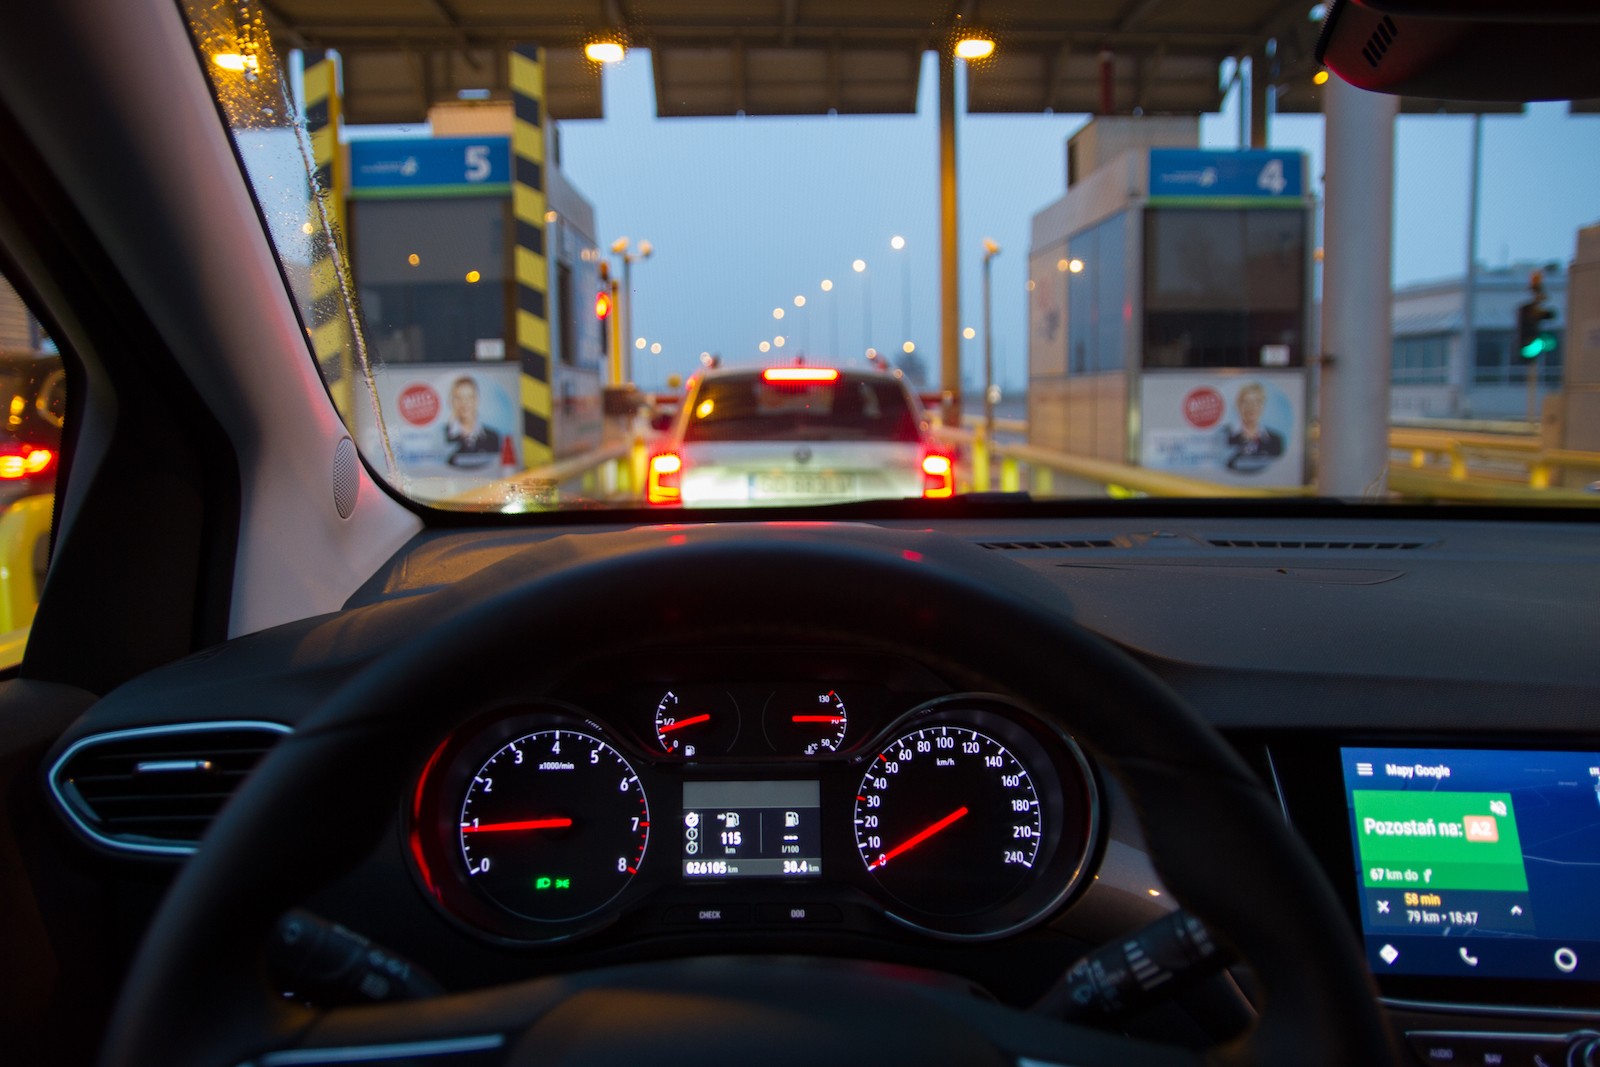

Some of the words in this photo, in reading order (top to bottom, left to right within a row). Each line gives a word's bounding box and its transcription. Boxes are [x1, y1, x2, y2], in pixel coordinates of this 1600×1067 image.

[462, 143, 493, 184] 5
[1254, 157, 1289, 196] 4
[674, 696, 678, 704] 1
[818, 694, 830, 703] 130
[663, 718, 675, 726] 1/2
[551, 741, 561, 755] 4
[673, 740, 678, 748] 0
[821, 738, 831, 747] 50
[918, 741, 930, 752] 80
[936, 737, 953, 748] 100
[962, 742, 979, 753] 120
[514, 750, 524, 764] 3
[590, 750, 600, 764] 5
[899, 749, 912, 760] 60
[538, 762, 575, 770] x1000/min
[886, 762, 898, 773] 50
[985, 756, 1002, 767] 140
[1385, 763, 1414, 779] Mapy
[1414, 763, 1451, 779] Google
[484, 778, 493, 792] 2
[619, 778, 629, 792] 6
[873, 778, 887, 790] 40
[1001, 776, 1020, 787] 160
[867, 796, 880, 808] 30
[1012, 800, 1029, 811] 180
[472, 818, 480, 831] 1
[630, 817, 640, 831] 7
[865, 816, 878, 827] 20
[1363, 817, 1436, 836] Pozostań
[1438, 822, 1463, 837] na:
[1469, 821, 1492, 837] A2
[720, 831, 742, 845] 115
[1013, 826, 1031, 838] 210
[868, 836, 881, 848] 10
[725, 846, 737, 854] km
[781, 845, 800, 853] l/100
[879, 854, 887, 866] 0
[1004, 852, 1024, 864] 240
[480, 857, 491, 872] 0
[617, 857, 627, 872] 8
[686, 861, 727, 874] 026105
[727, 864, 739, 874] km
[783, 860, 808, 874] 30.4
[808, 863, 820, 873] km
[1369, 867, 1385, 882] 67
[1386, 868, 1403, 881] km
[1404, 868, 1419, 882] do
[1404, 892, 1419, 907] 58
[1420, 893, 1442, 906] min
[699, 911, 721, 919] CHECK
[1406, 909, 1421, 924] 79
[1422, 910, 1440, 924] km
[1448, 911, 1479, 925] 18:47
[1430, 1048, 1453, 1058] AUDIO
[1484, 1053, 1503, 1065] NAV
